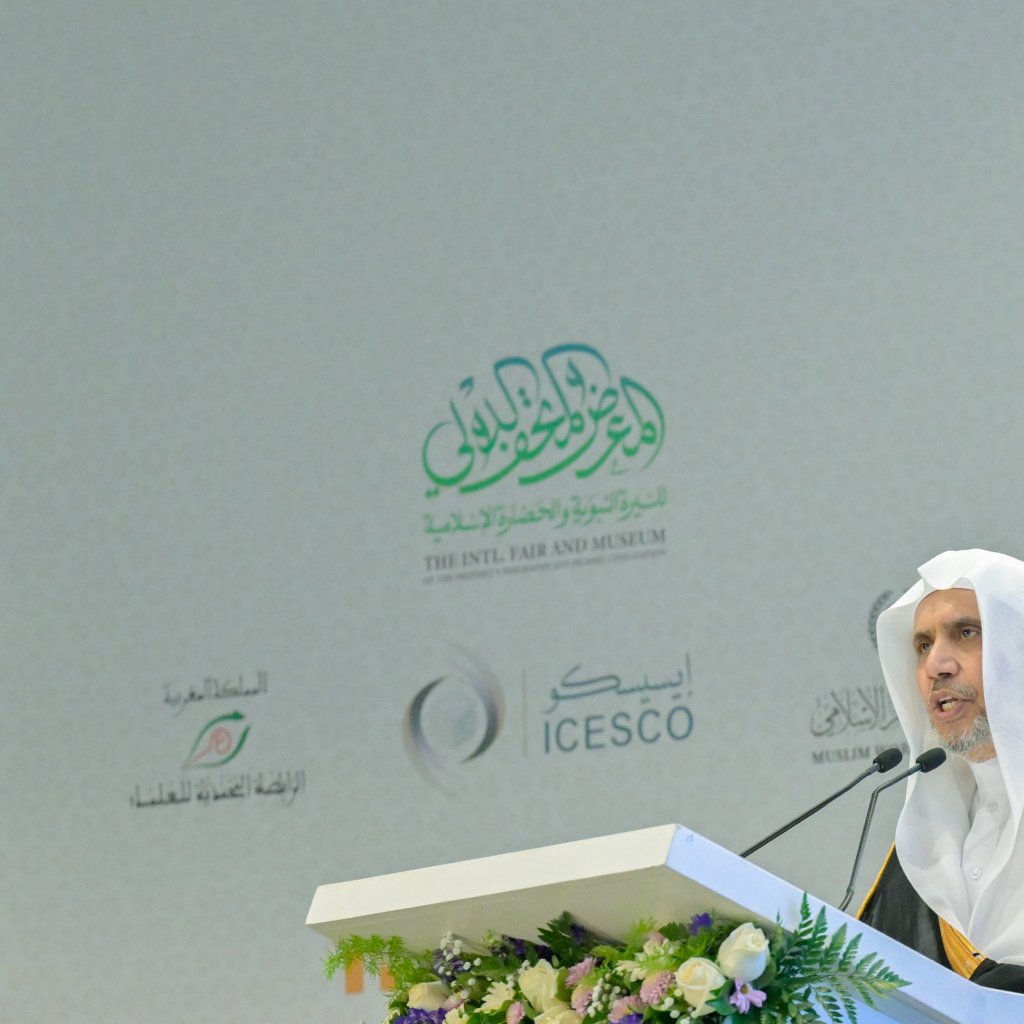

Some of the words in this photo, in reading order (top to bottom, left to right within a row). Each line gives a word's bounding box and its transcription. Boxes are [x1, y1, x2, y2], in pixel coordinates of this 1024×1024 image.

[424, 554, 458, 572] THE
[510, 542, 548, 561] FAIR
[553, 537, 585, 556] AND
[591, 528, 667, 551] MUSEUM
[542, 704, 694, 755] ICESCO
[811, 745, 870, 764] MUSLIM
